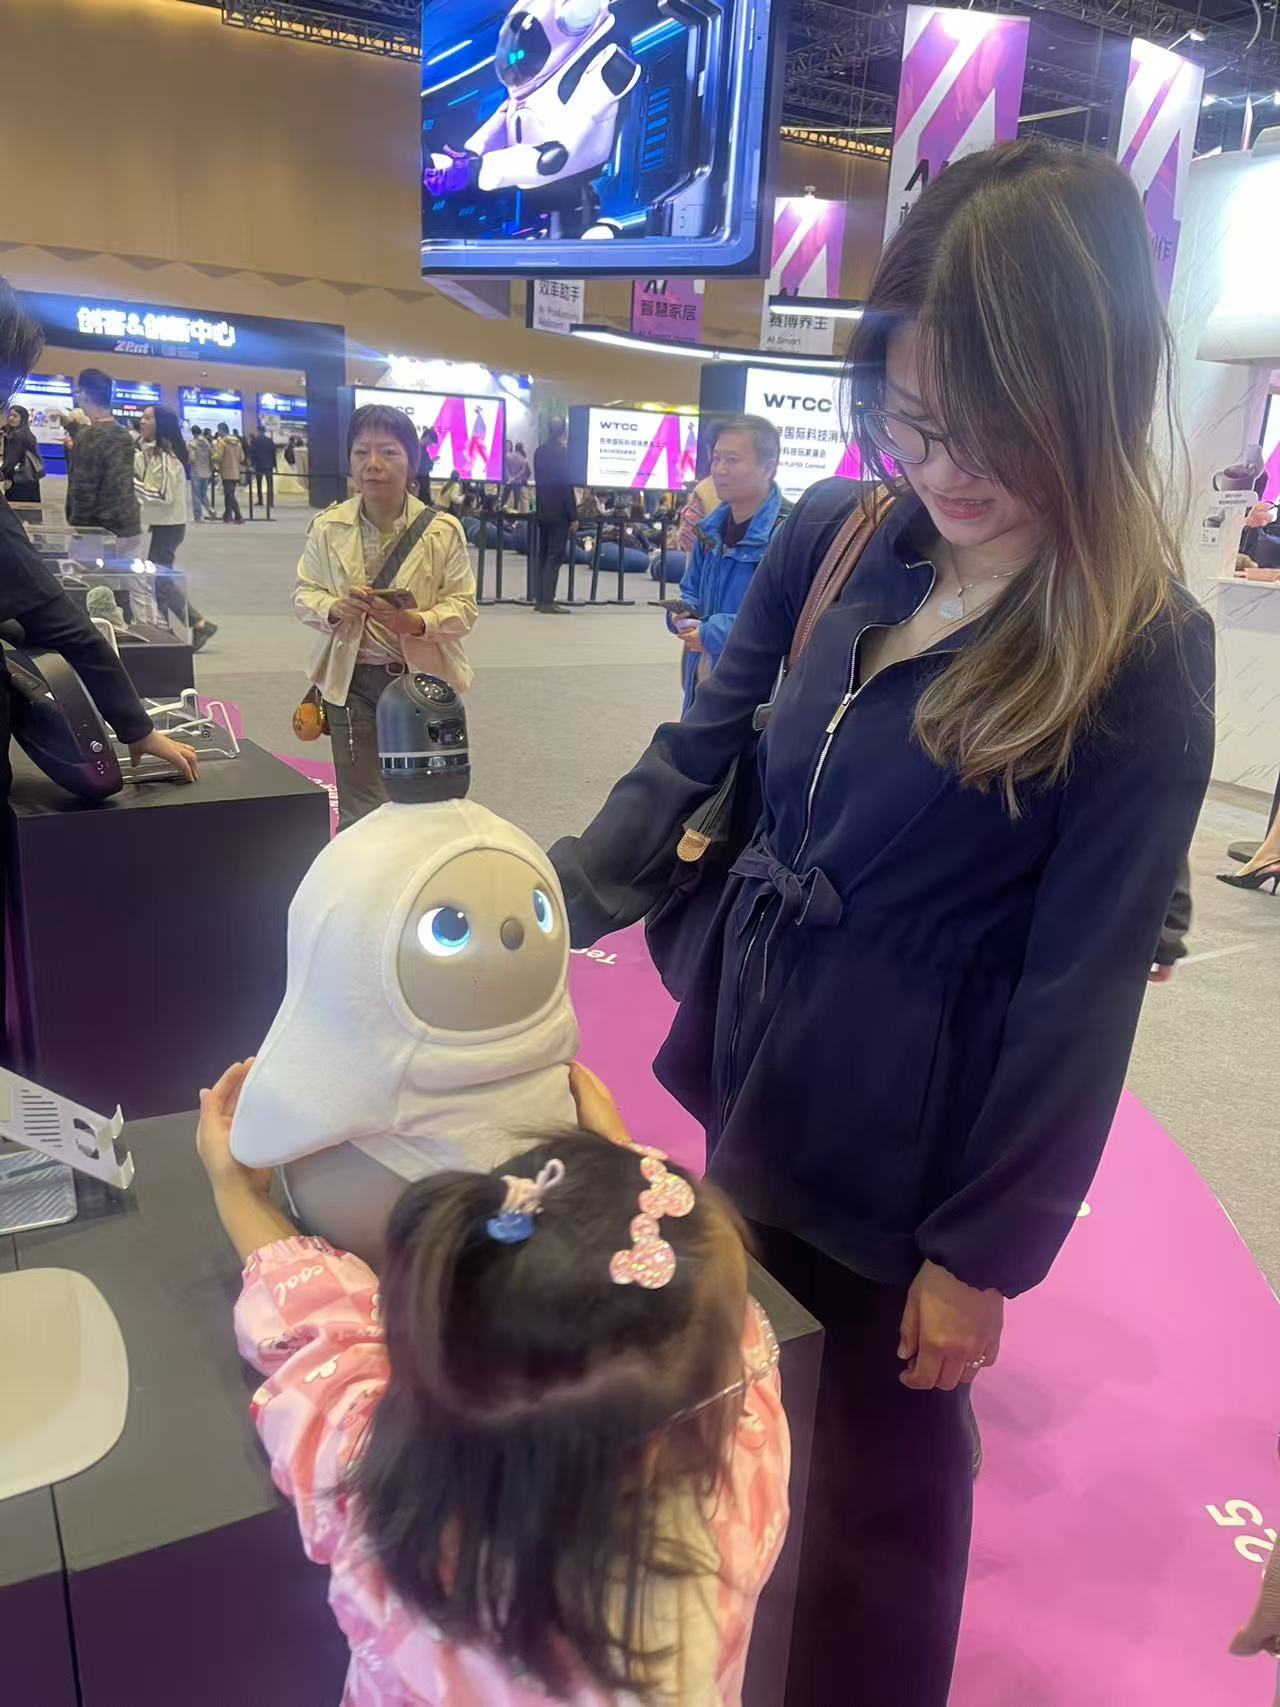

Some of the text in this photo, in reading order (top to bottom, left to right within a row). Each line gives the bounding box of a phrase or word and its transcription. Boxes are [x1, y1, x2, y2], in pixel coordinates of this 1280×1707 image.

[640, 299, 697, 321] 智慧家居
[763, 392, 832, 413] WTCC
[600, 421, 638, 431] WTCC
[273, 1265, 324, 1307] cool
[1204, 1499, 1278, 1579] 25
